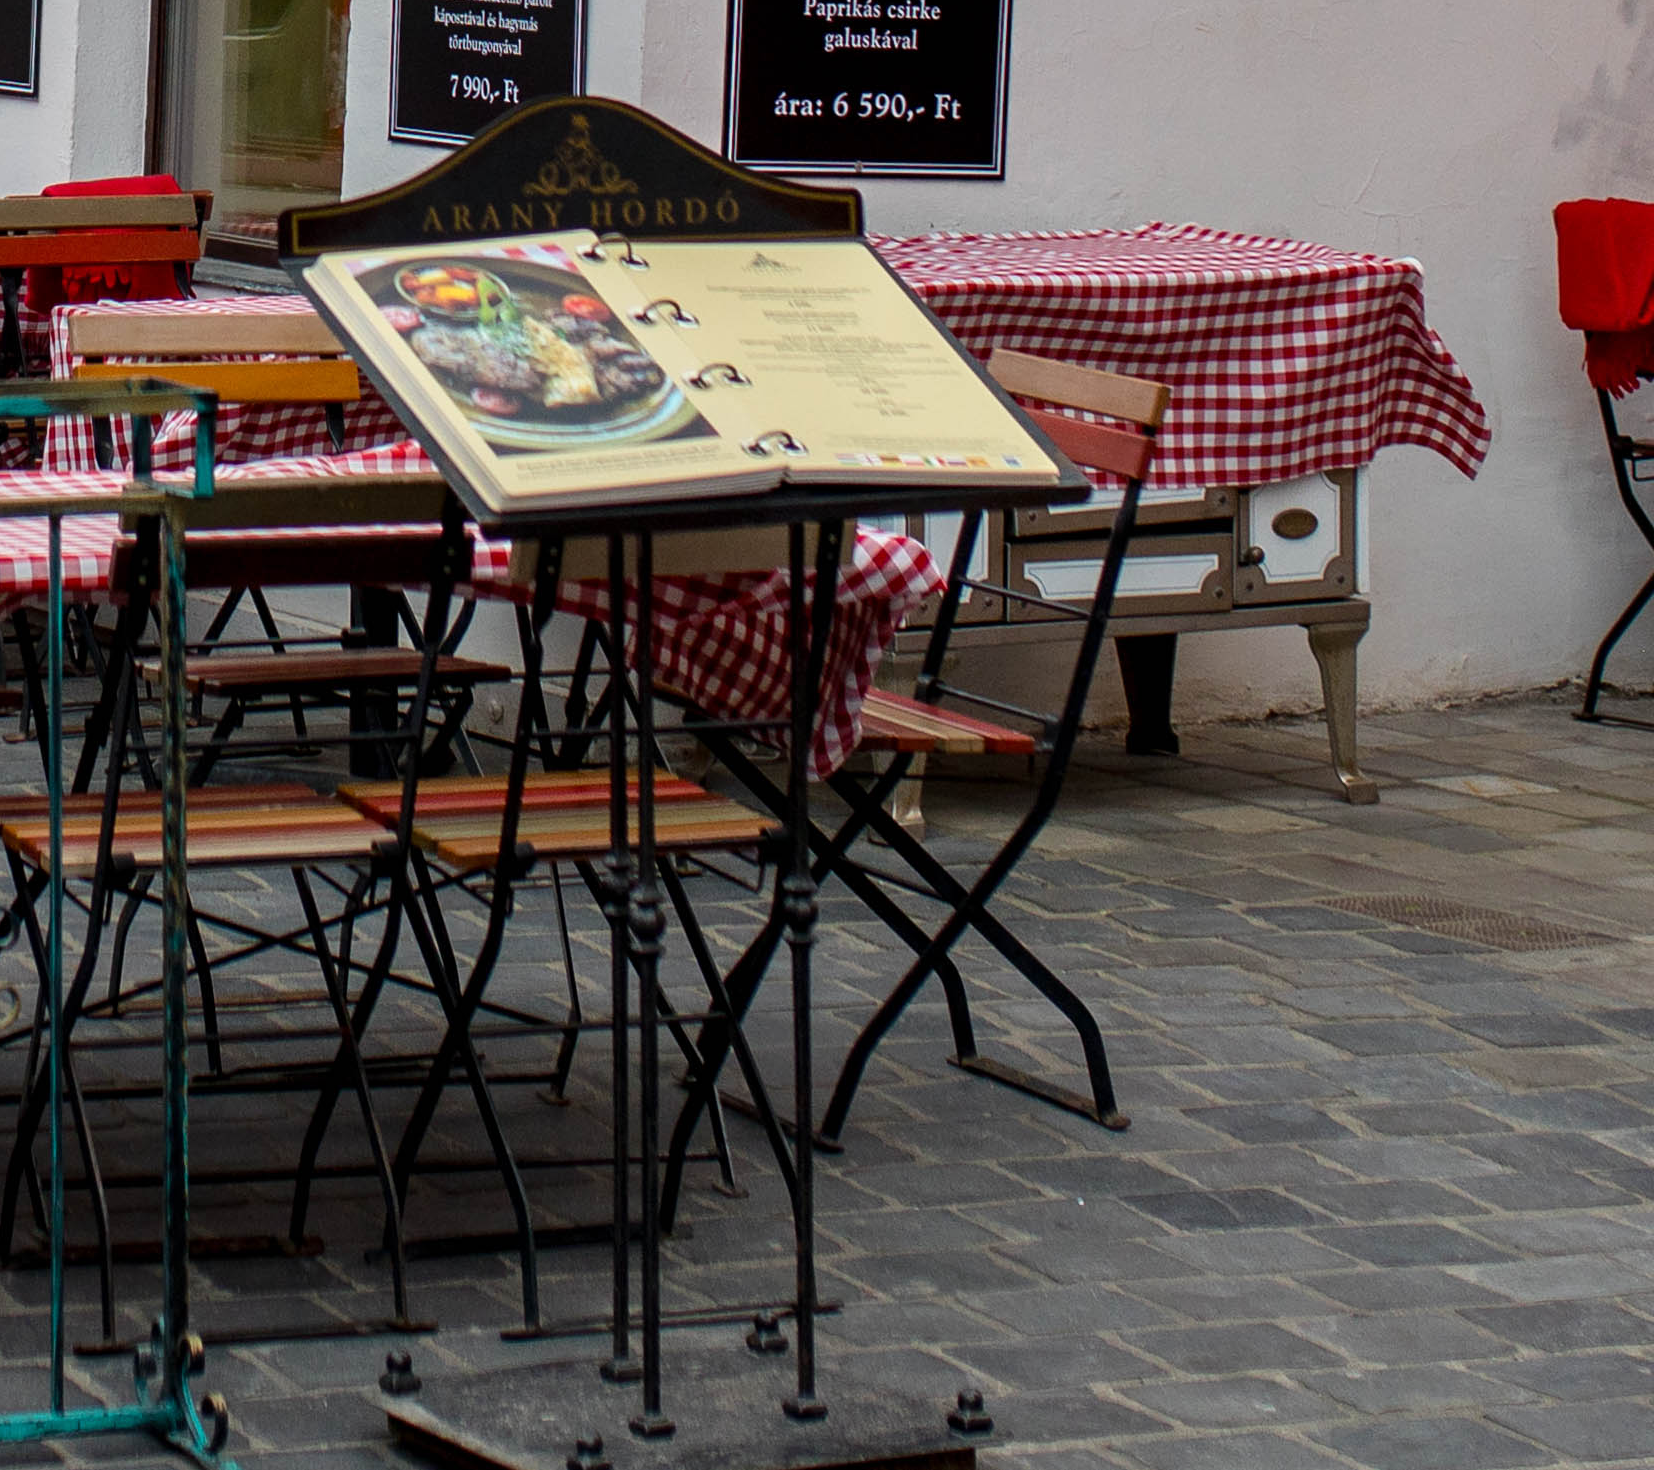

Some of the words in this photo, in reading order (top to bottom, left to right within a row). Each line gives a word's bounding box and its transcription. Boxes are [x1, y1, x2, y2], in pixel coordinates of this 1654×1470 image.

[434, 6, 485, 28] káposztával
[487, 11, 496, 26] és
[498, 13, 538, 34] hagymás
[448, 34, 522, 57] törtburgonyával
[824, 26, 918, 52] galuskával
[450, 74, 458, 97] 7
[463, 75, 500, 104] 990,-
[503, 78, 520, 104] Ft
[774, 92, 824, 116] ára:
[833, 92, 849, 117] 6
[857, 93, 925, 122] 590,-
[934, 93, 961, 120] Ft
[422, 201, 564, 233] ARANY
[589, 189, 741, 227] HORDÓ
